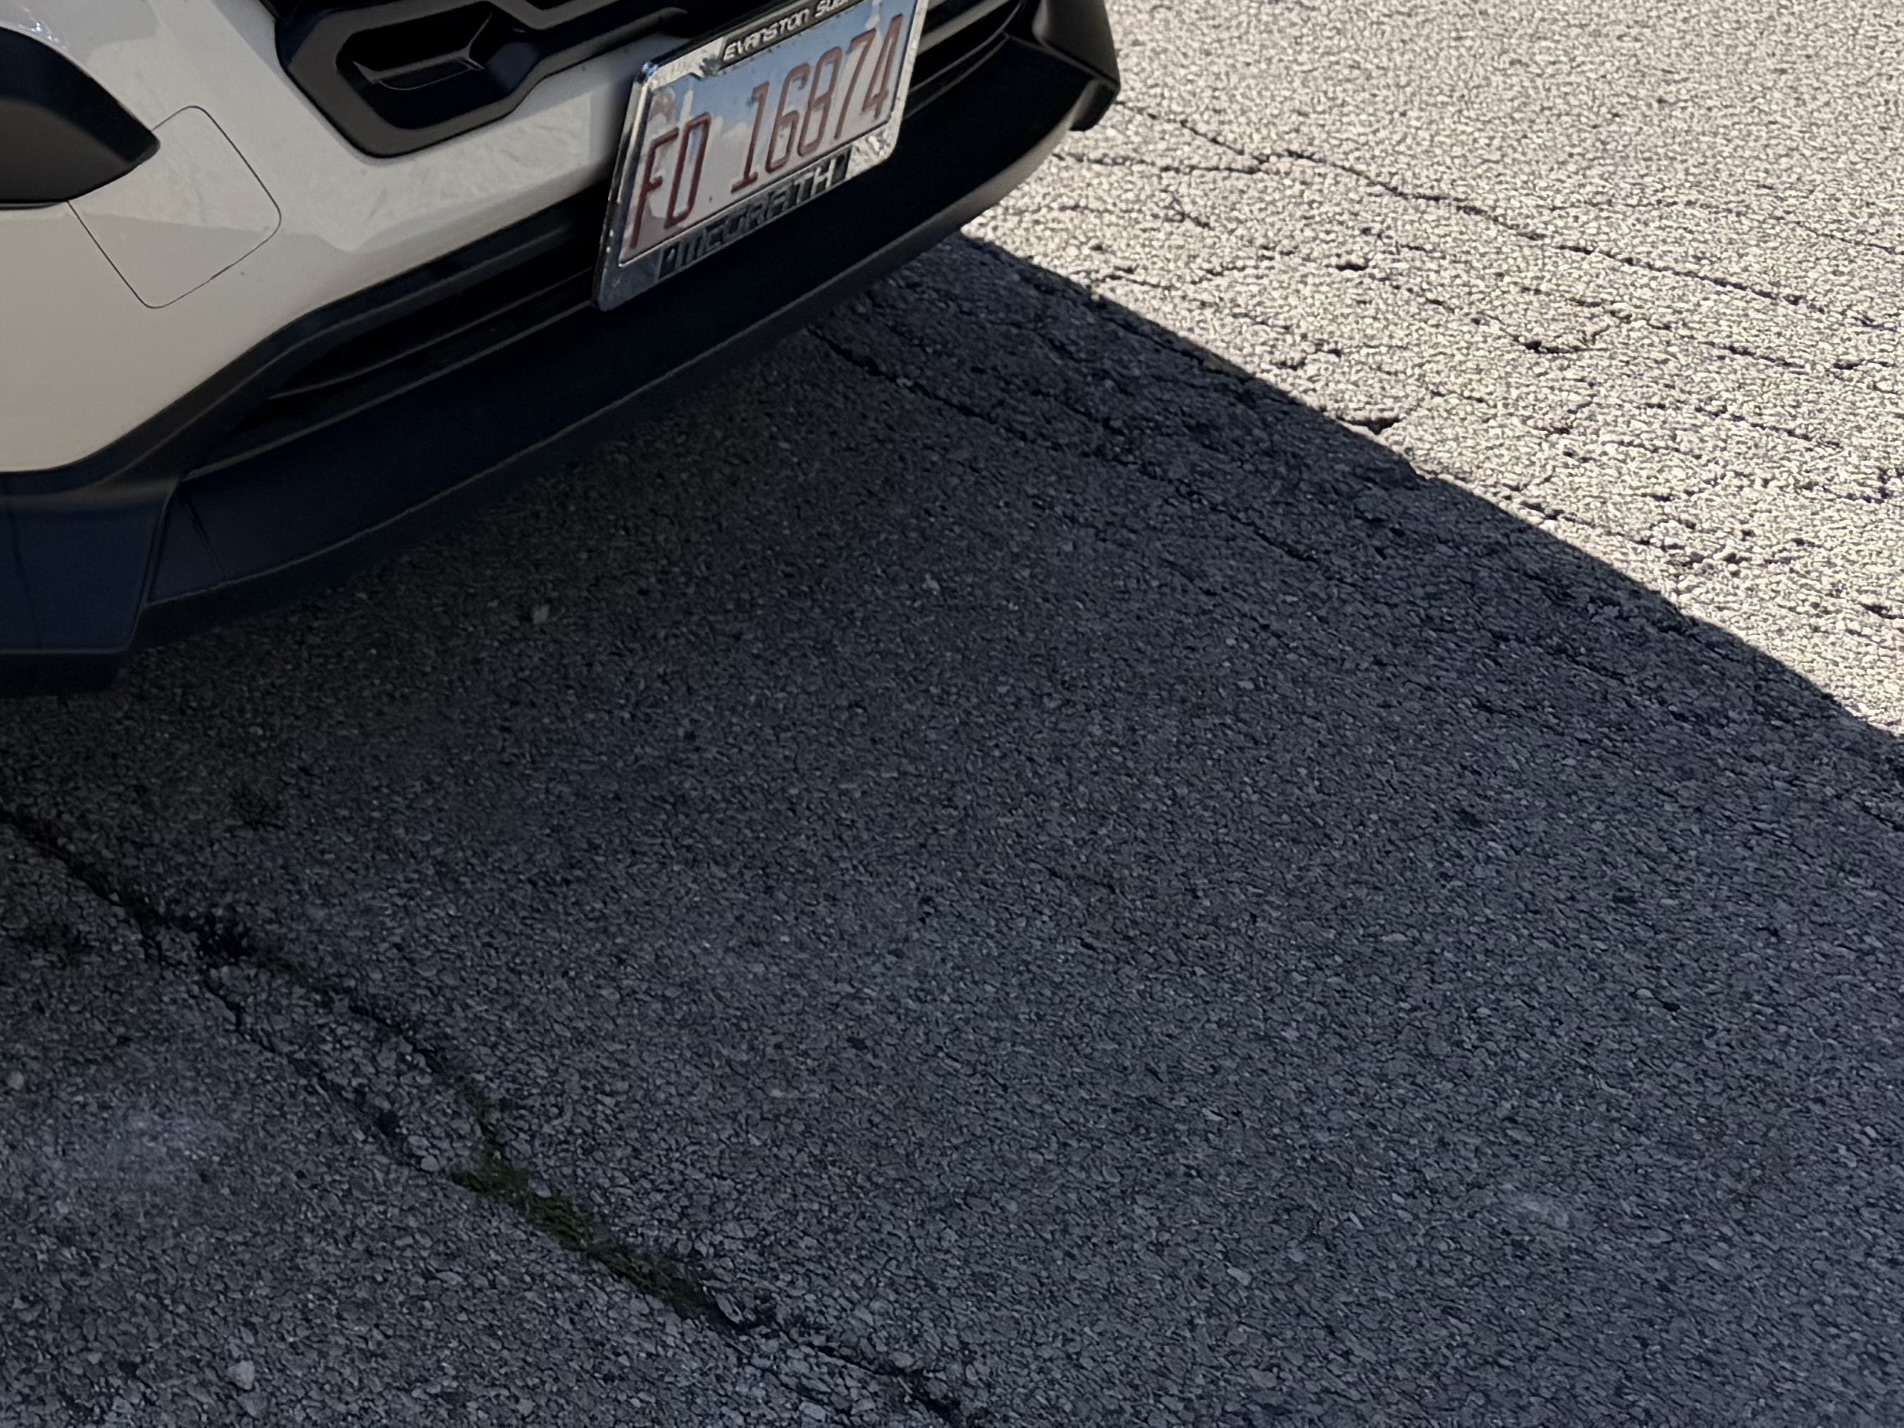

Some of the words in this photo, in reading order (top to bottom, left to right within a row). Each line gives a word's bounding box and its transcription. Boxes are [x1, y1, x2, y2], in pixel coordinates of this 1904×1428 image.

[723, 8, 810, 62] EVANSTON
[630, 111, 713, 250] FD
[730, 12, 905, 195] 16874
